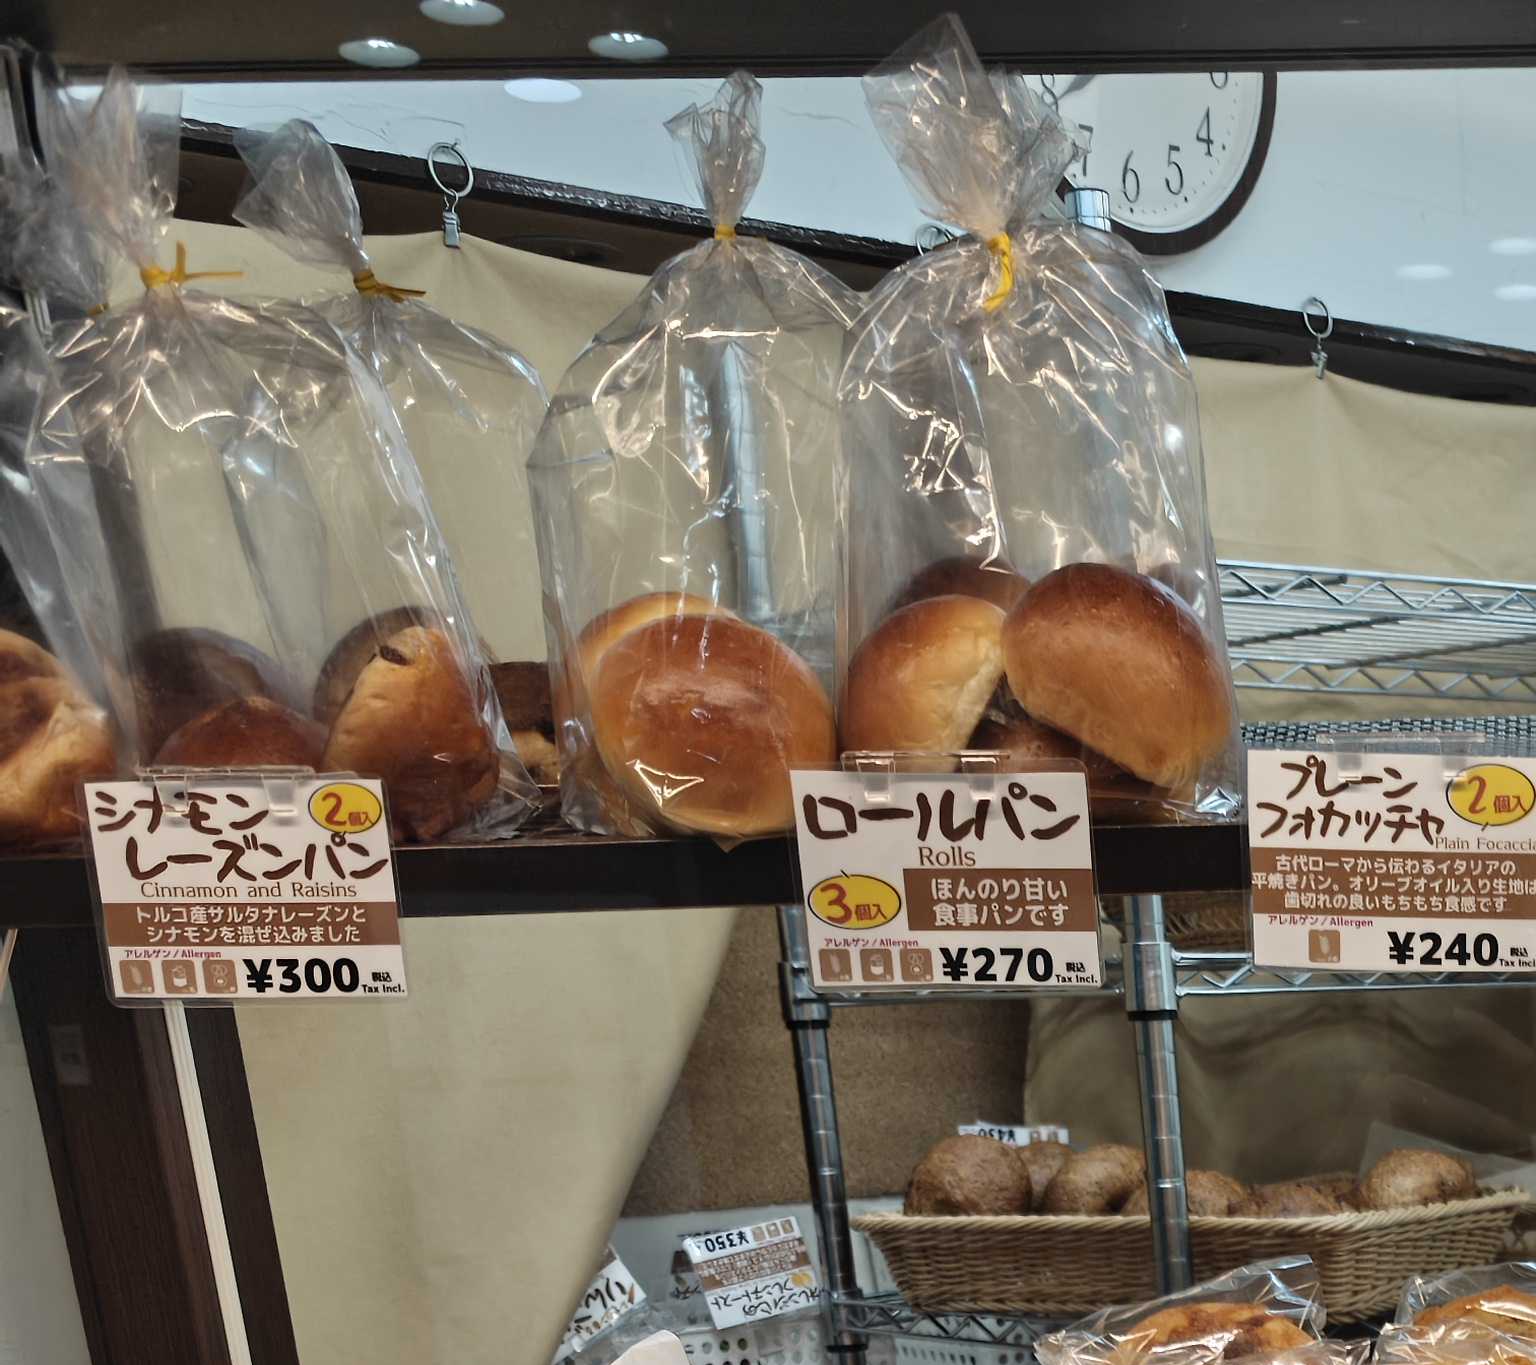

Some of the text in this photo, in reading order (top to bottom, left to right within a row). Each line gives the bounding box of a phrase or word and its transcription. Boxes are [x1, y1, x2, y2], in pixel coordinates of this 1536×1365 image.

[1280, 755, 1418, 800] プレーン
[95, 786, 269, 835] シナモン
[803, 782, 1080, 841] ロールパン
[1257, 801, 1444, 845] フォカッチャ
[918, 846, 976, 867] Rolls
[1435, 837, 1470, 850] Plain
[126, 832, 388, 883] レーズンパン
[1276, 855, 1516, 876] 古代ローマから伝わるイタリアの
[140, 881, 357, 898] Cinnamon and Raisins
[931, 878, 1067, 900] ほんのり甘い
[136, 906, 366, 925] トルコ産サルタナレーズンと
[933, 904, 1068, 926] 食事パンです
[147, 925, 360, 943] シナモンを混ぜ込みました
[1388, 932, 1498, 966] ¥240
[242, 957, 359, 993] ¥300
[940, 948, 1053, 981] ¥270
